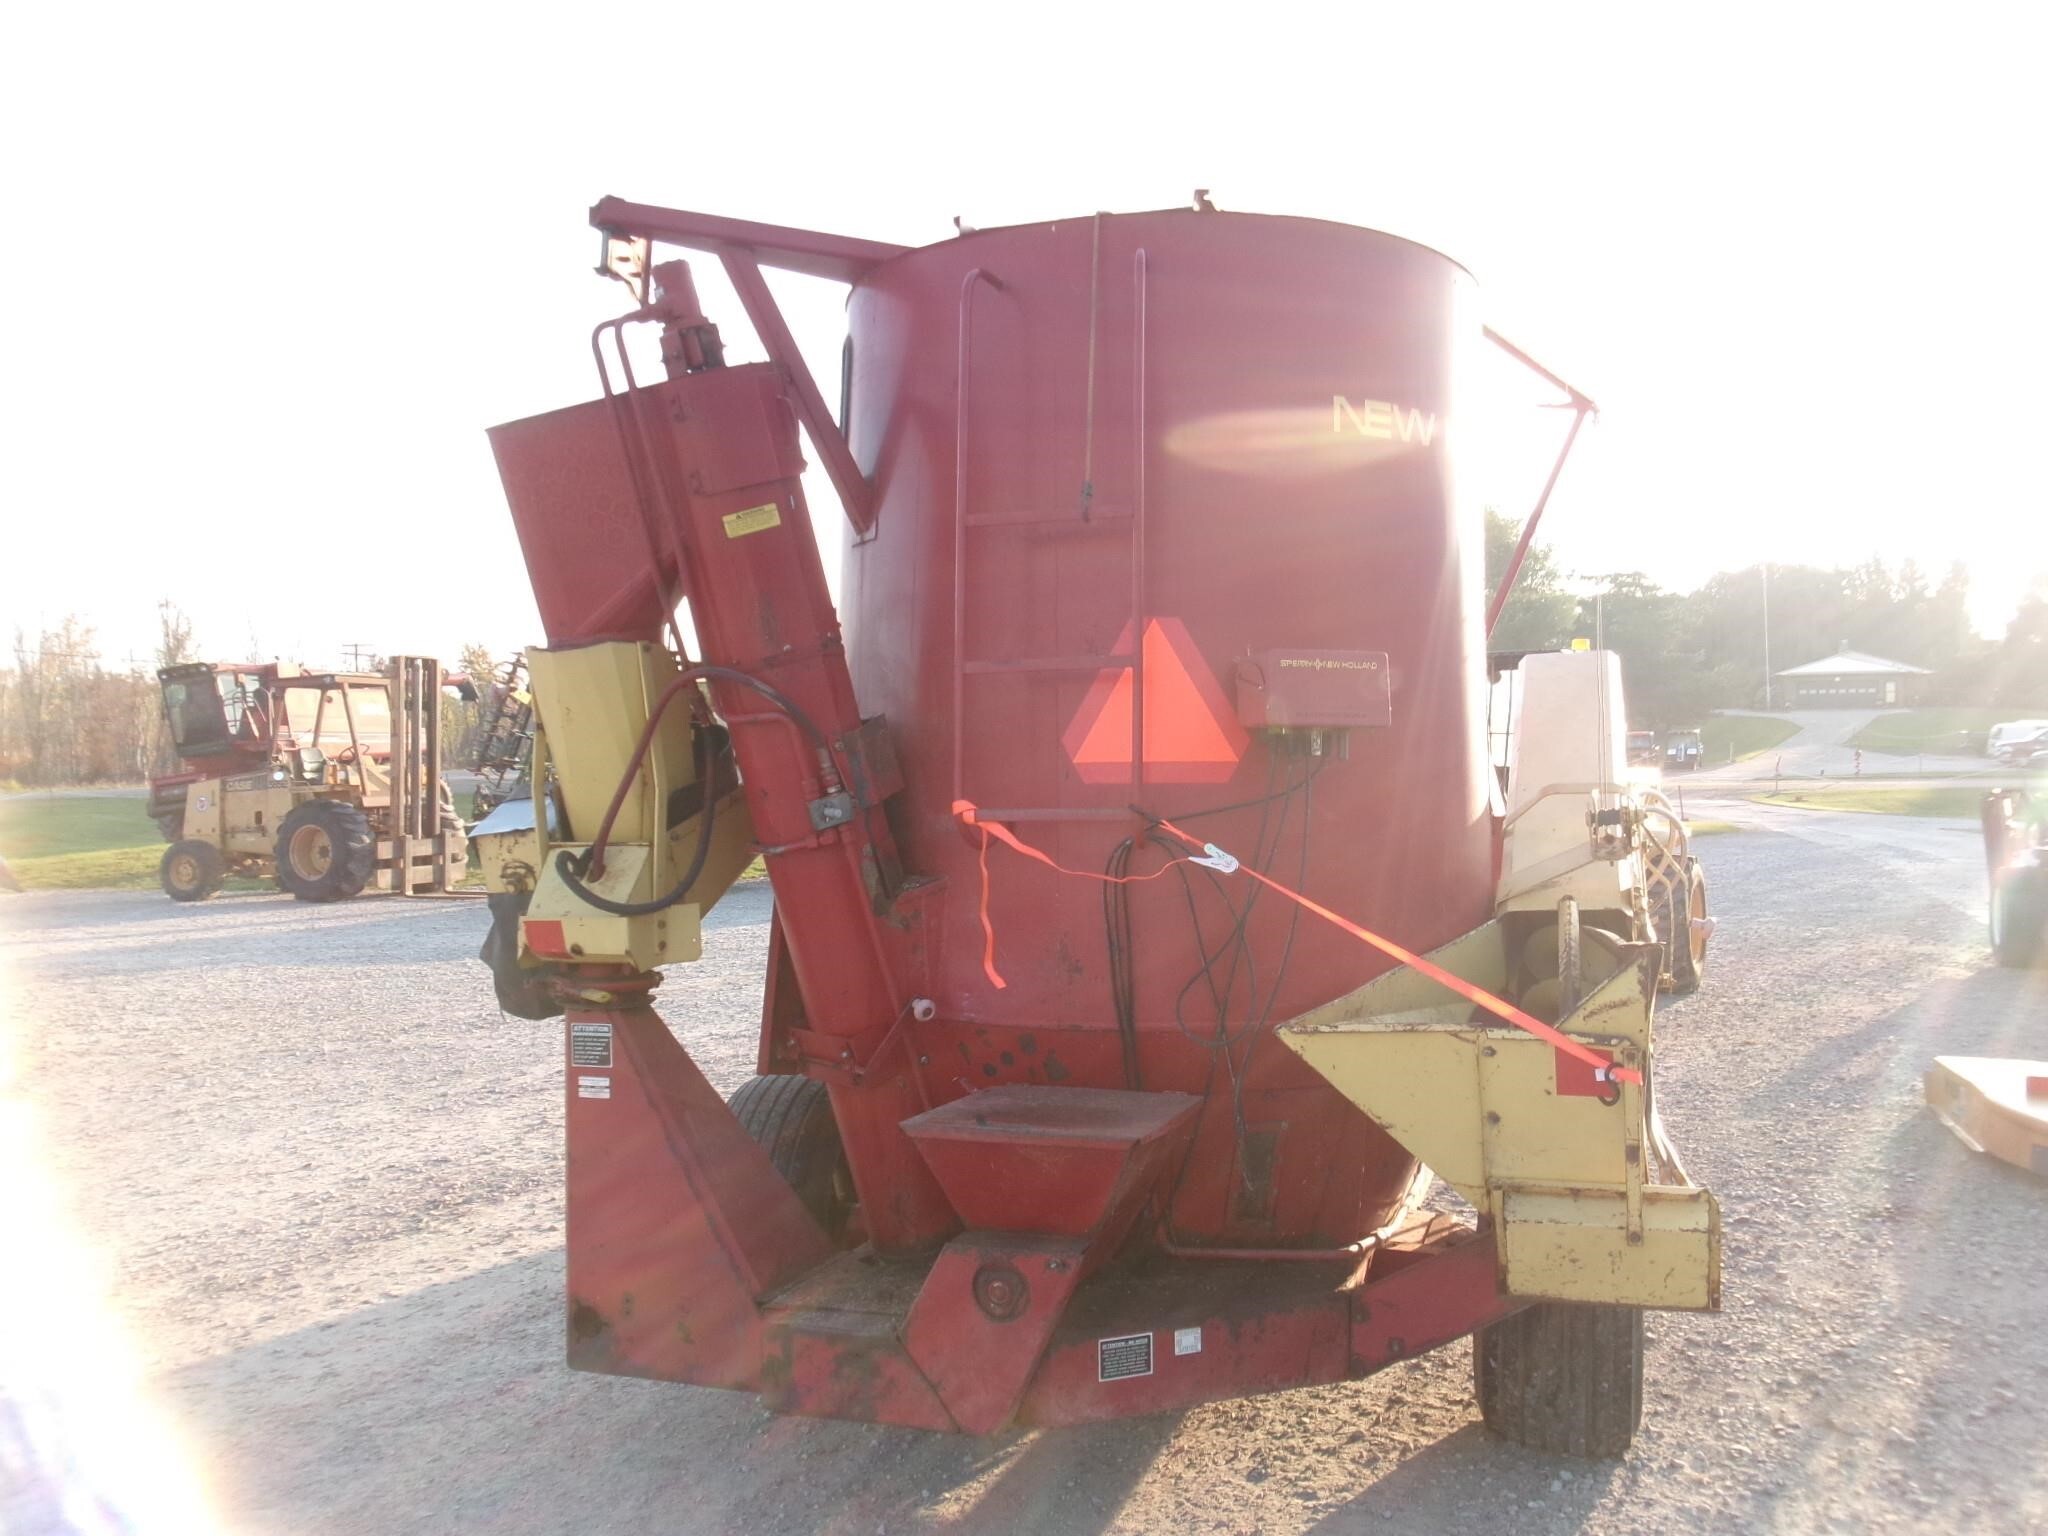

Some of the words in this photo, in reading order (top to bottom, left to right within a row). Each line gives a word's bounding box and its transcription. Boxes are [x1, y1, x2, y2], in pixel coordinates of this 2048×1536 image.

[1333, 395, 1435, 446] NEW
[1323, 660, 1340, 669] NEW
[1341, 661, 1377, 670] HOLLAND
